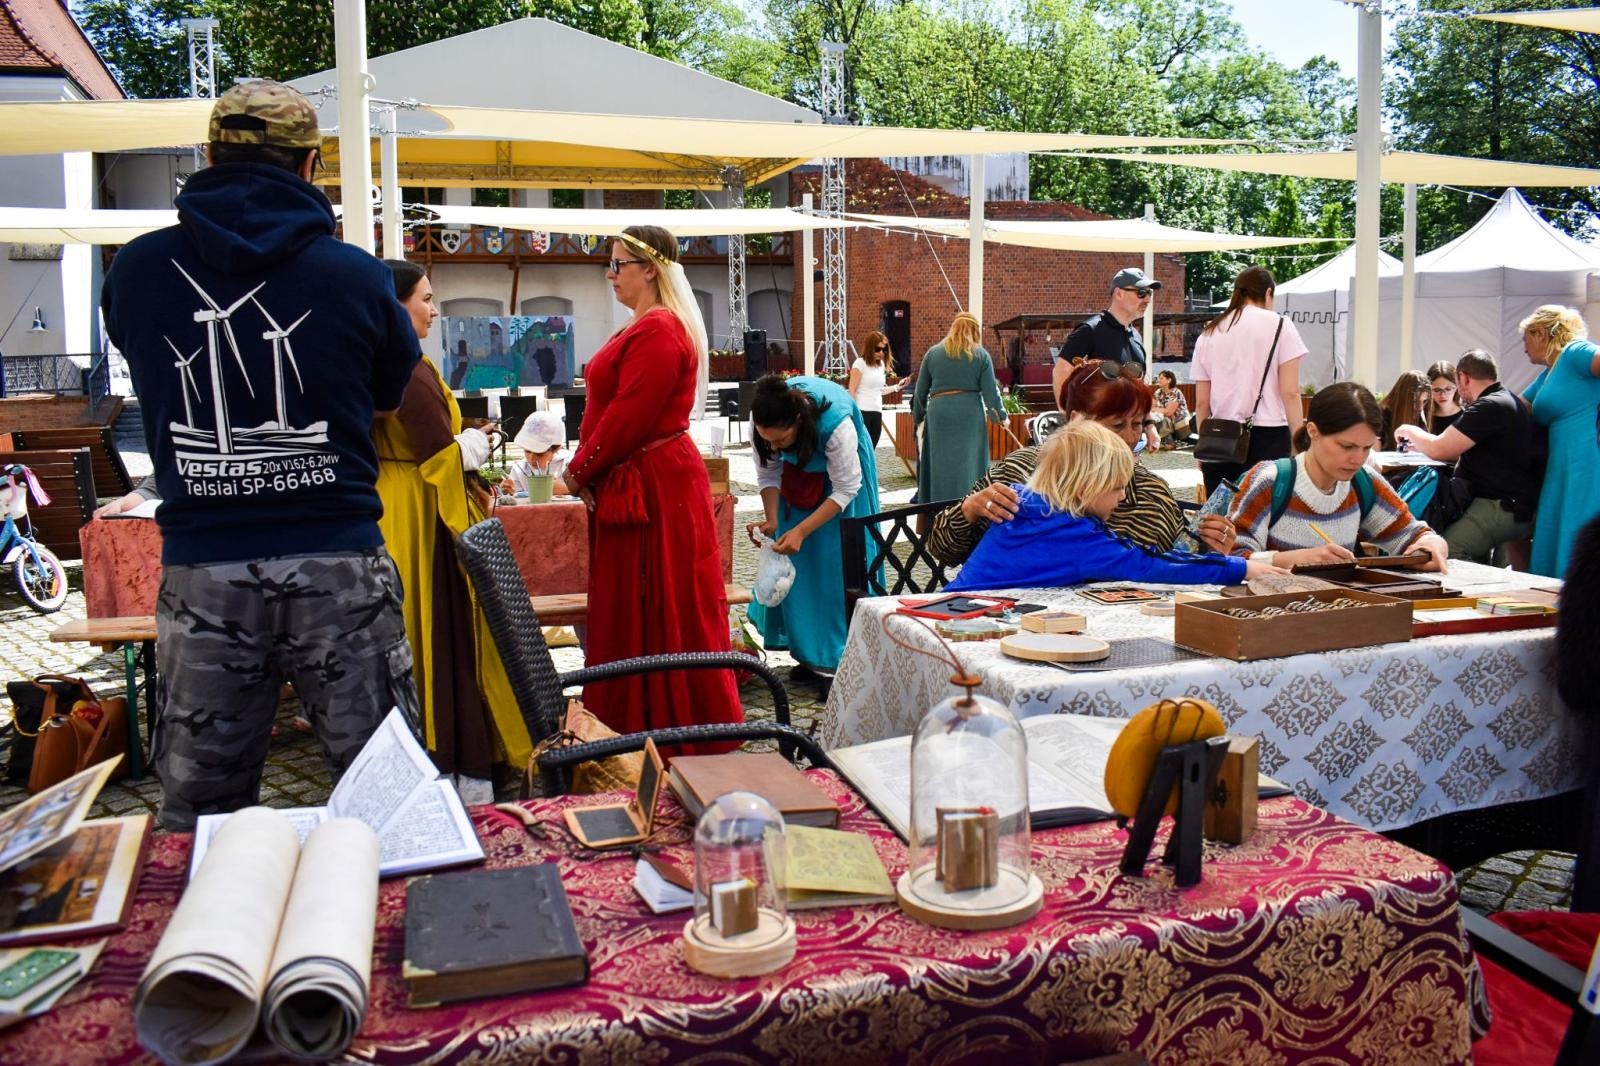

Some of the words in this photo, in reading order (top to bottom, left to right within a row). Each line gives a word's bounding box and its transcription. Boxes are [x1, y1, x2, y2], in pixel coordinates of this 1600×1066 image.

[175, 458, 263, 477] Vestas
[263, 462, 281, 474] 20x
[282, 455, 339, 470] V162-6.2MW
[184, 479, 238, 496] Telsiai
[242, 468, 336, 495] SP-66468
